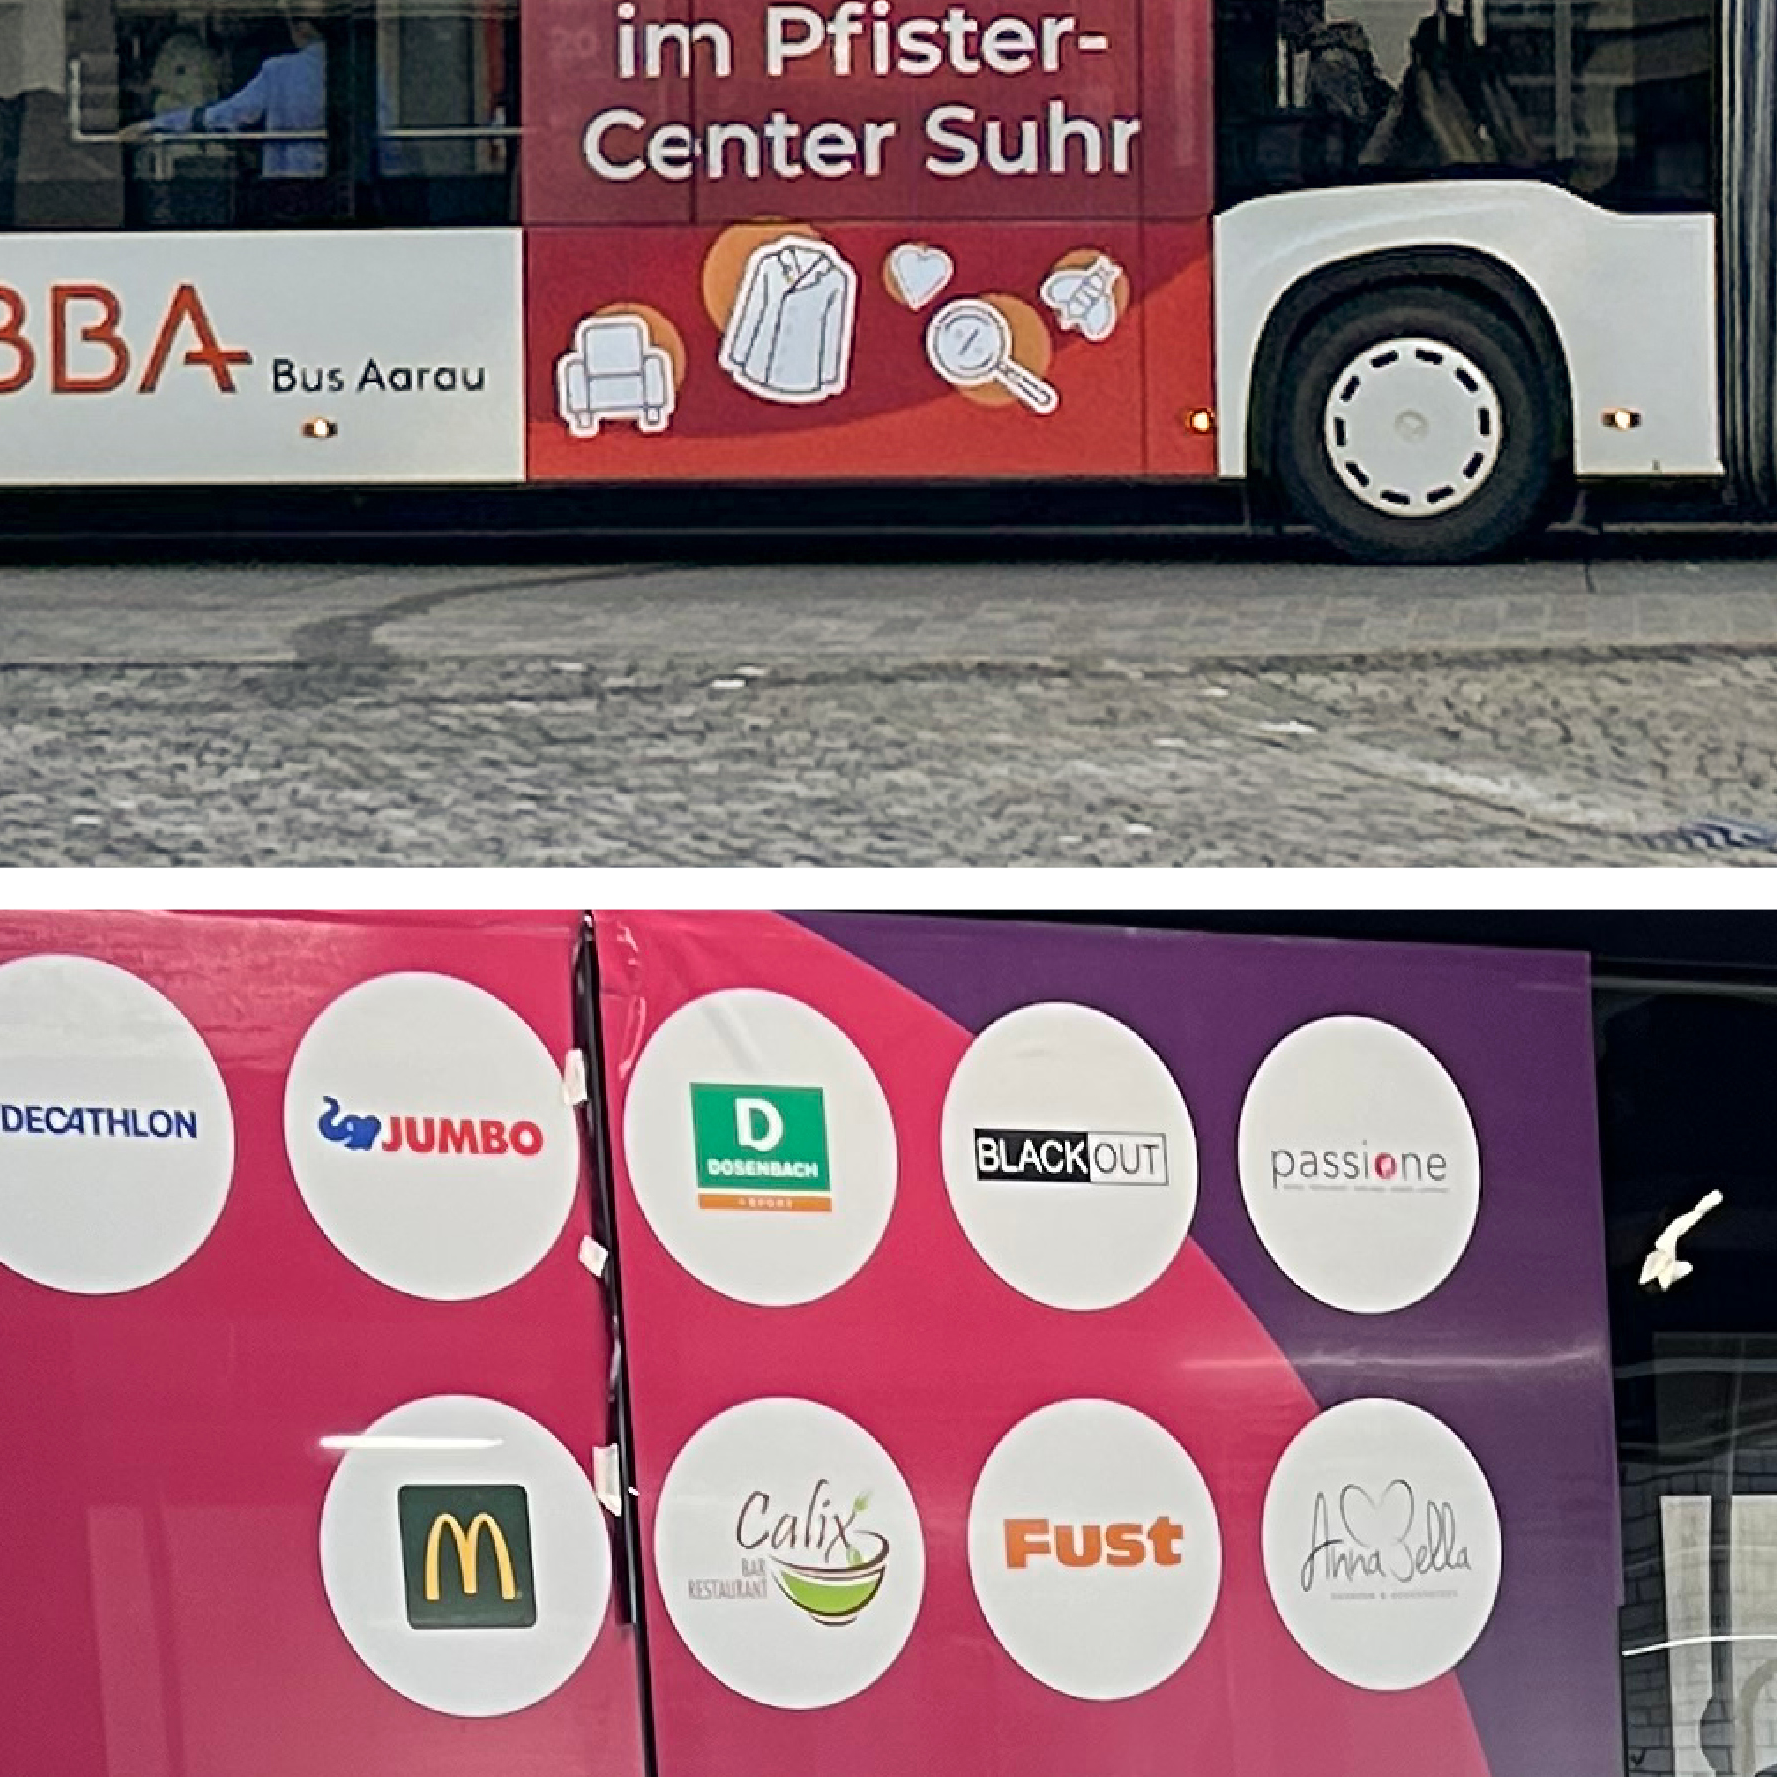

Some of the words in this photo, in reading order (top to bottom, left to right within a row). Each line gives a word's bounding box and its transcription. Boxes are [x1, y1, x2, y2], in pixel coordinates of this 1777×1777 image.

[616, 1, 733, 79] im
[581, 107, 898, 180] Center
[924, 98, 1142, 176] Suhr
[271, 356, 345, 393] Bus
[356, 356, 487, 393] Aarau
[0, 1102, 198, 1140] DECATHLON
[381, 1115, 544, 1157] JUMBO
[734, 1097, 784, 1153] D
[706, 1158, 820, 1178] DOSENBACH
[1270, 1139, 1448, 1190] passione
[736, 1477, 862, 1564] Calix
[1002, 1515, 1184, 1570] Fust
[688, 1578, 768, 1600] RESTAURANT
